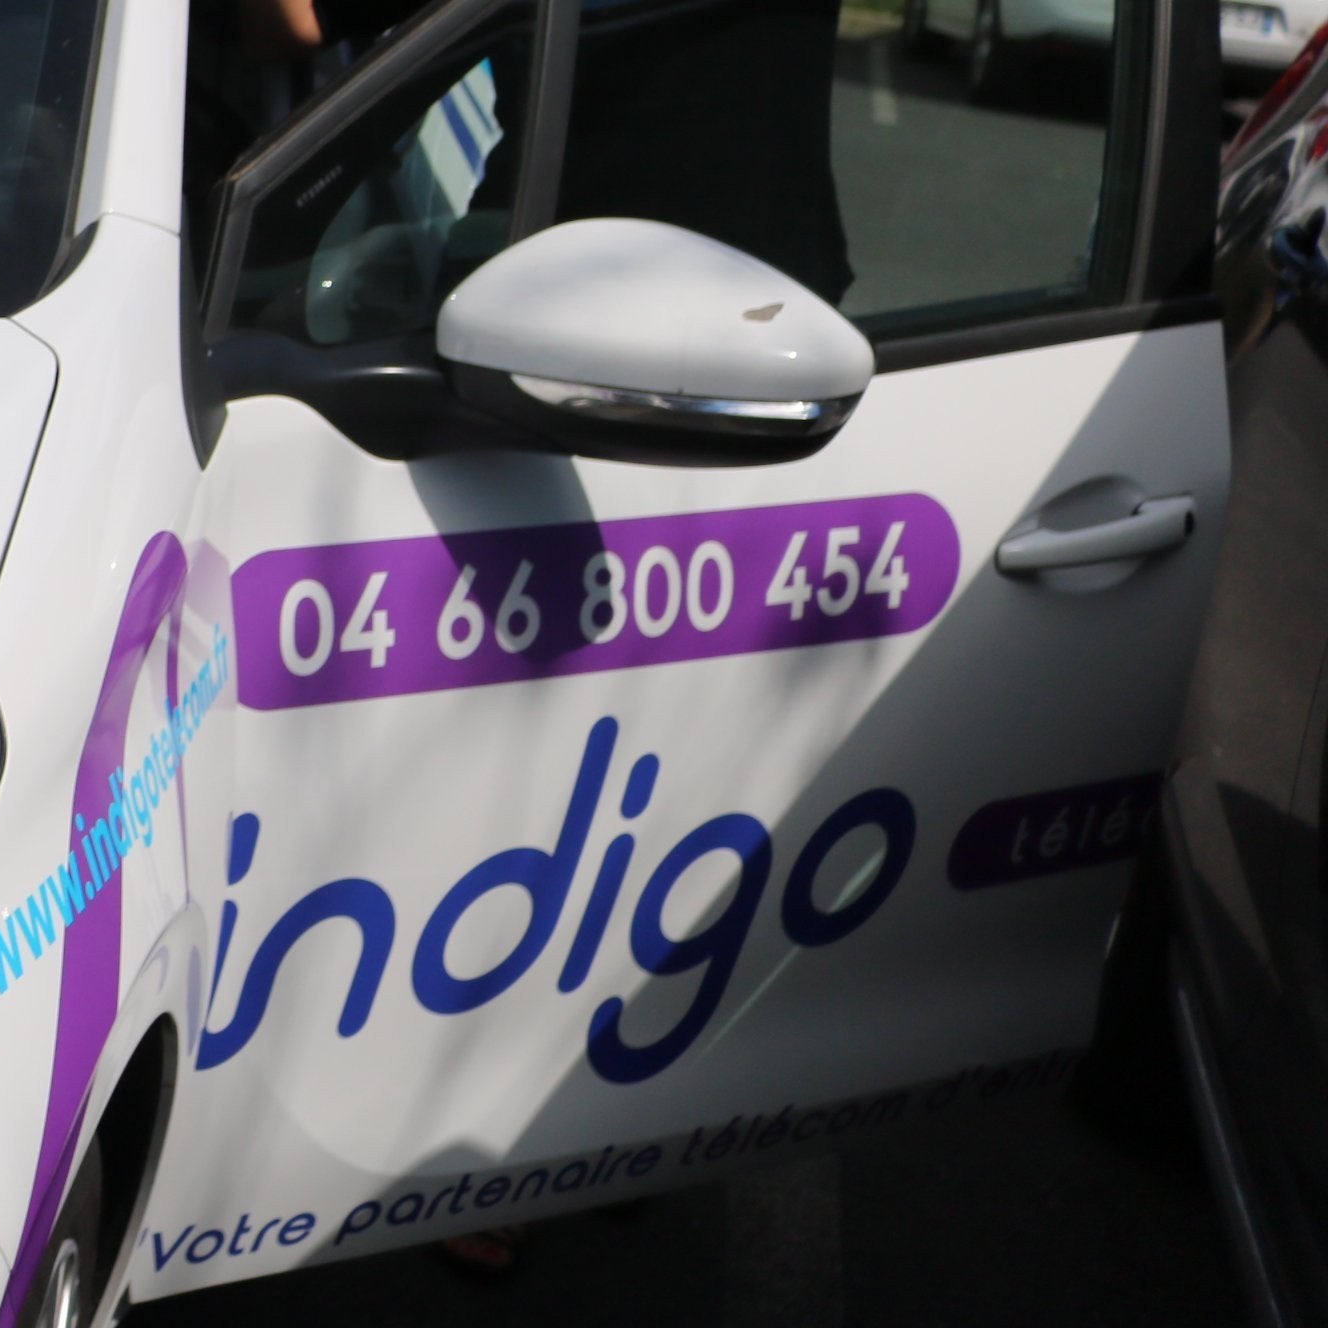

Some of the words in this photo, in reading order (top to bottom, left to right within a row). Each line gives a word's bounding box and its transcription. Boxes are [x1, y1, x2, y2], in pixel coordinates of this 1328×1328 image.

[278, 571, 397, 678] 04
[435, 559, 542, 662] 66
[579, 539, 735, 645] 800
[764, 520, 910, 621] 454
[195, 715, 917, 1085] indigo
[151, 1209, 317, 1272] Votre
[333, 1142, 663, 1247] partenaire
[679, 1090, 909, 1169] télécom
